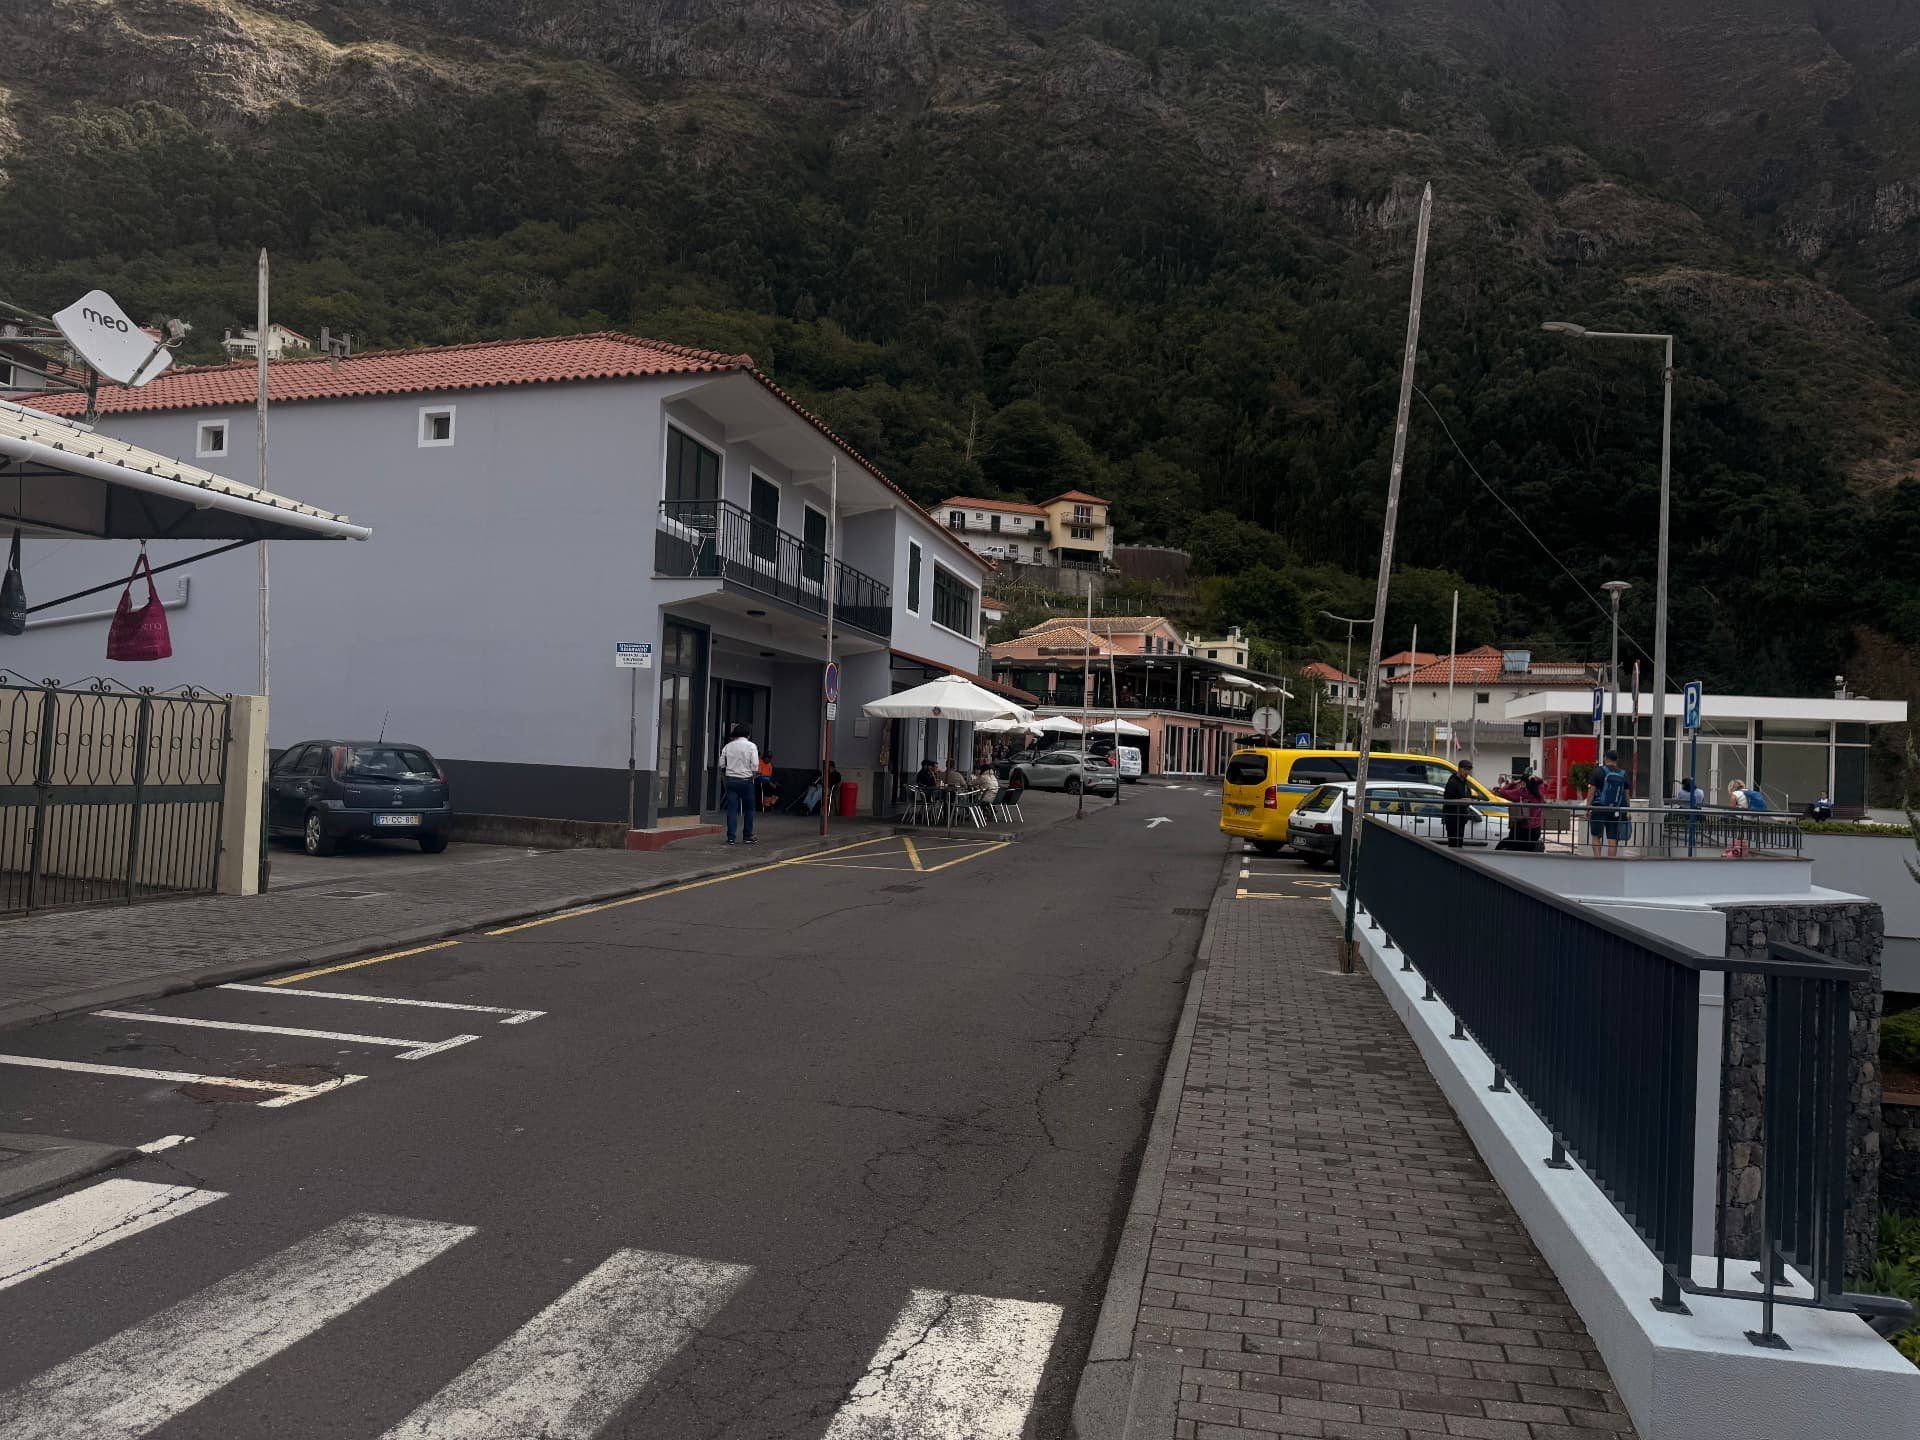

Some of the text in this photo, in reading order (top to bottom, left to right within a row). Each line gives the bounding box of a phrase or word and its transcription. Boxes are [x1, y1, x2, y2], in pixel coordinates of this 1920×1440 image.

[83, 308, 128, 332] meo
[1594, 691, 1602, 718] P
[1687, 687, 1697, 725] P
